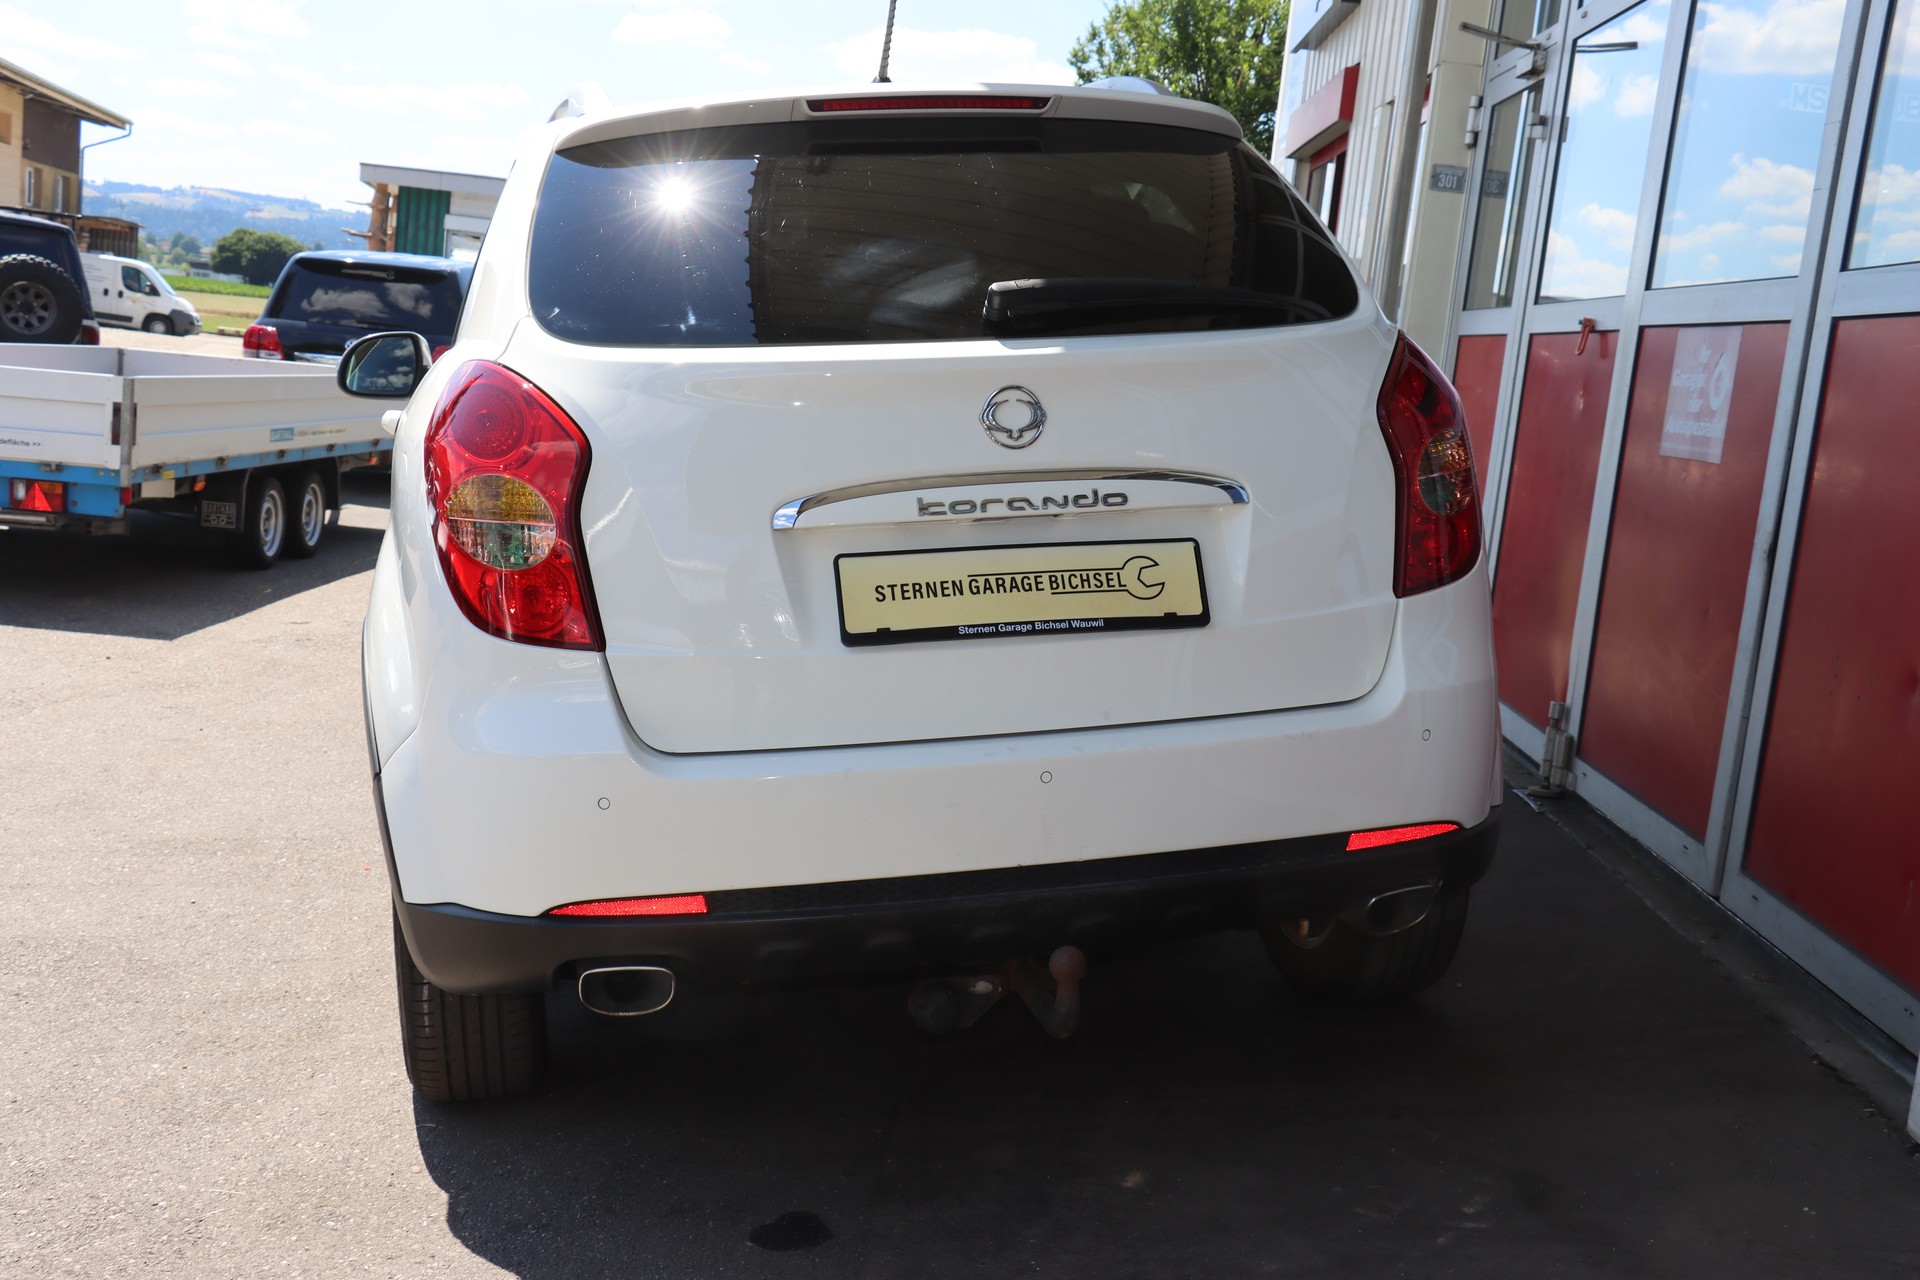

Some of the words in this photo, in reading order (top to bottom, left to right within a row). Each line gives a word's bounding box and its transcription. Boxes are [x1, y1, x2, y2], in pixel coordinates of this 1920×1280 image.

[1438, 173, 1458, 190] 301
[916, 488, 1129, 517] korando
[874, 579, 964, 602] STERNEN
[968, 575, 1046, 596] GARAGE
[1049, 571, 1127, 591] BICHSEL
[958, 625, 996, 635] Sternen
[998, 622, 1033, 633] Garage
[1035, 620, 1069, 630] Bichsel
[1071, 618, 1105, 628] Wauwil
